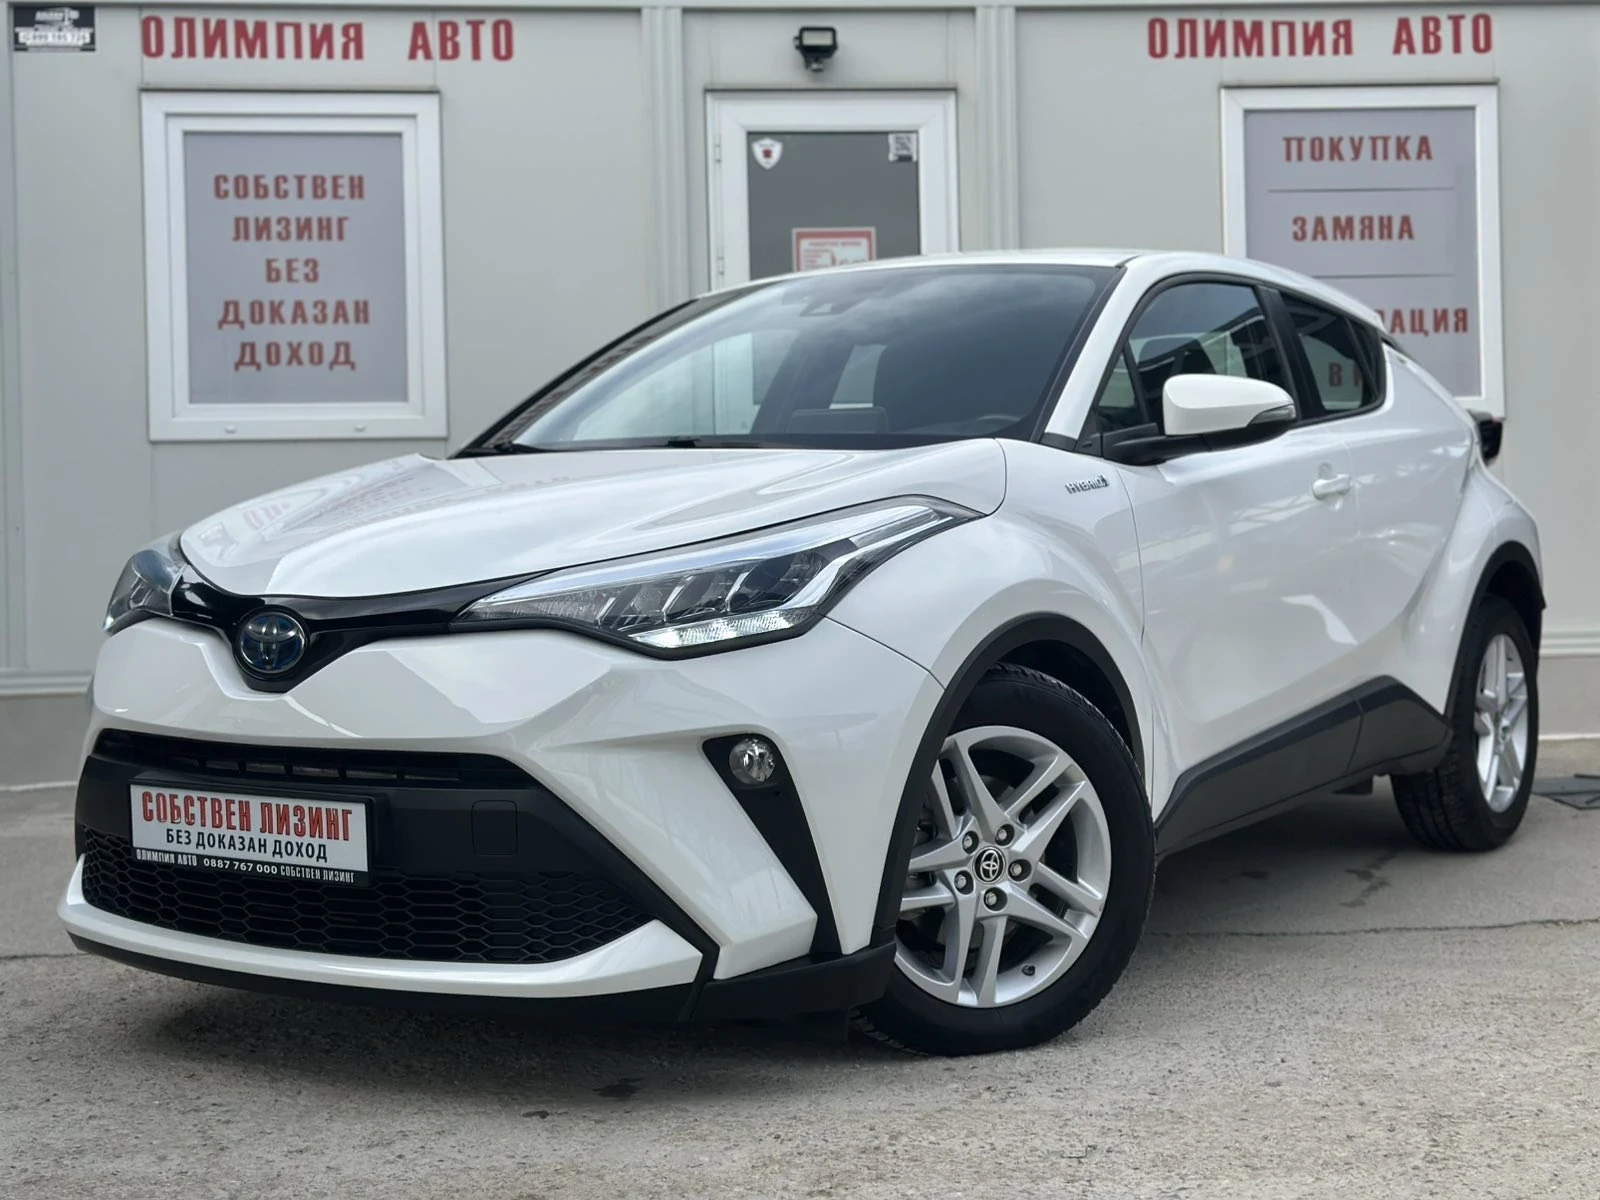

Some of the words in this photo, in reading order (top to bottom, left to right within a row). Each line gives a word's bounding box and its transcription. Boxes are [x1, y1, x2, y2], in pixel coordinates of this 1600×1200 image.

[140, 15, 364, 60] ОЛИМПИЯ
[408, 19, 514, 61] АВТО
[1147, 17, 1354, 59] ОЛИМПИЯ
[1393, 13, 1494, 55] АВТО
[1283, 135, 1433, 162] ПОКУПКА
[213, 174, 366, 200] СОБСТВЕН
[232, 216, 349, 242] ЛИЗИНГ
[1292, 215, 1415, 242] ЗАМЯНА
[265, 258, 320, 284] БЕЗ
[217, 299, 371, 330] ДОКАЗАН
[234, 341, 356, 371] ДОХОД
[142, 791, 252, 832] СОБСТВЕН
[260, 802, 353, 842] ЛИЗИНГ
[166, 828, 192, 846] БЕЗ
[196, 831, 267, 854] ДОКАЗАН
[272, 841, 328, 863] ДОХОД
[136, 849, 175, 864] ОЛИМПИЯ
[177, 854, 198, 867] АВТО
[203, 858, 231, 869] 0887
[233, 861, 254, 872] 767
[256, 863, 278, 874] 000
[280, 865, 321, 880] СОБСТВЕН
[323, 869, 355, 883] ЛИЗИНГ
